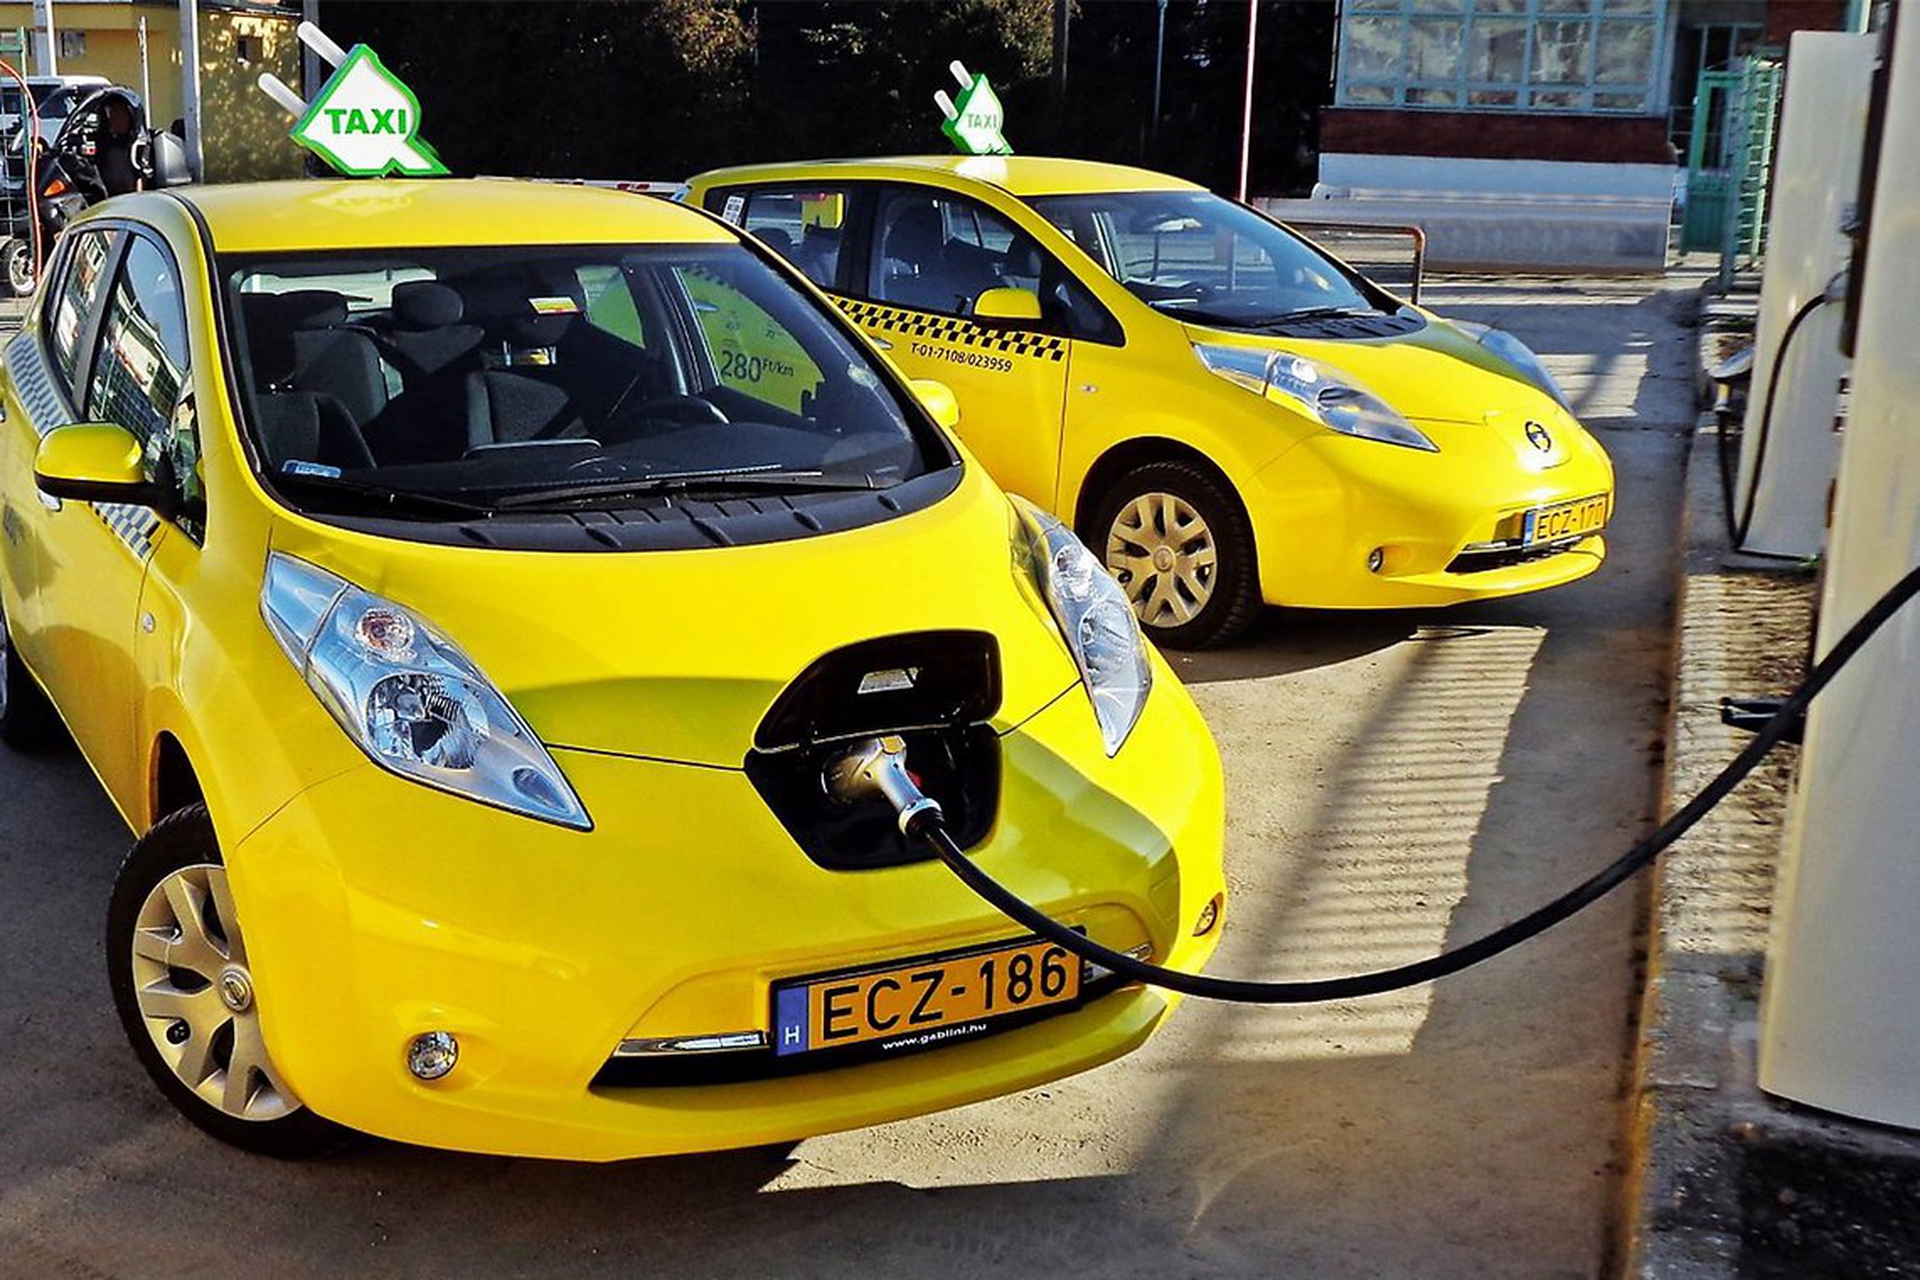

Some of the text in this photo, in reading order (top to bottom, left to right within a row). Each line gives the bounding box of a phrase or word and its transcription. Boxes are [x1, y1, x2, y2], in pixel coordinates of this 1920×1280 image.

[324, 108, 407, 134] TAXI
[967, 113, 998, 129] TAXI
[720, 349, 762, 382] 280
[822, 946, 1068, 1041] ECZ-186
[784, 1024, 801, 1046] H
[881, 1022, 987, 1051] www.gablini.hu
